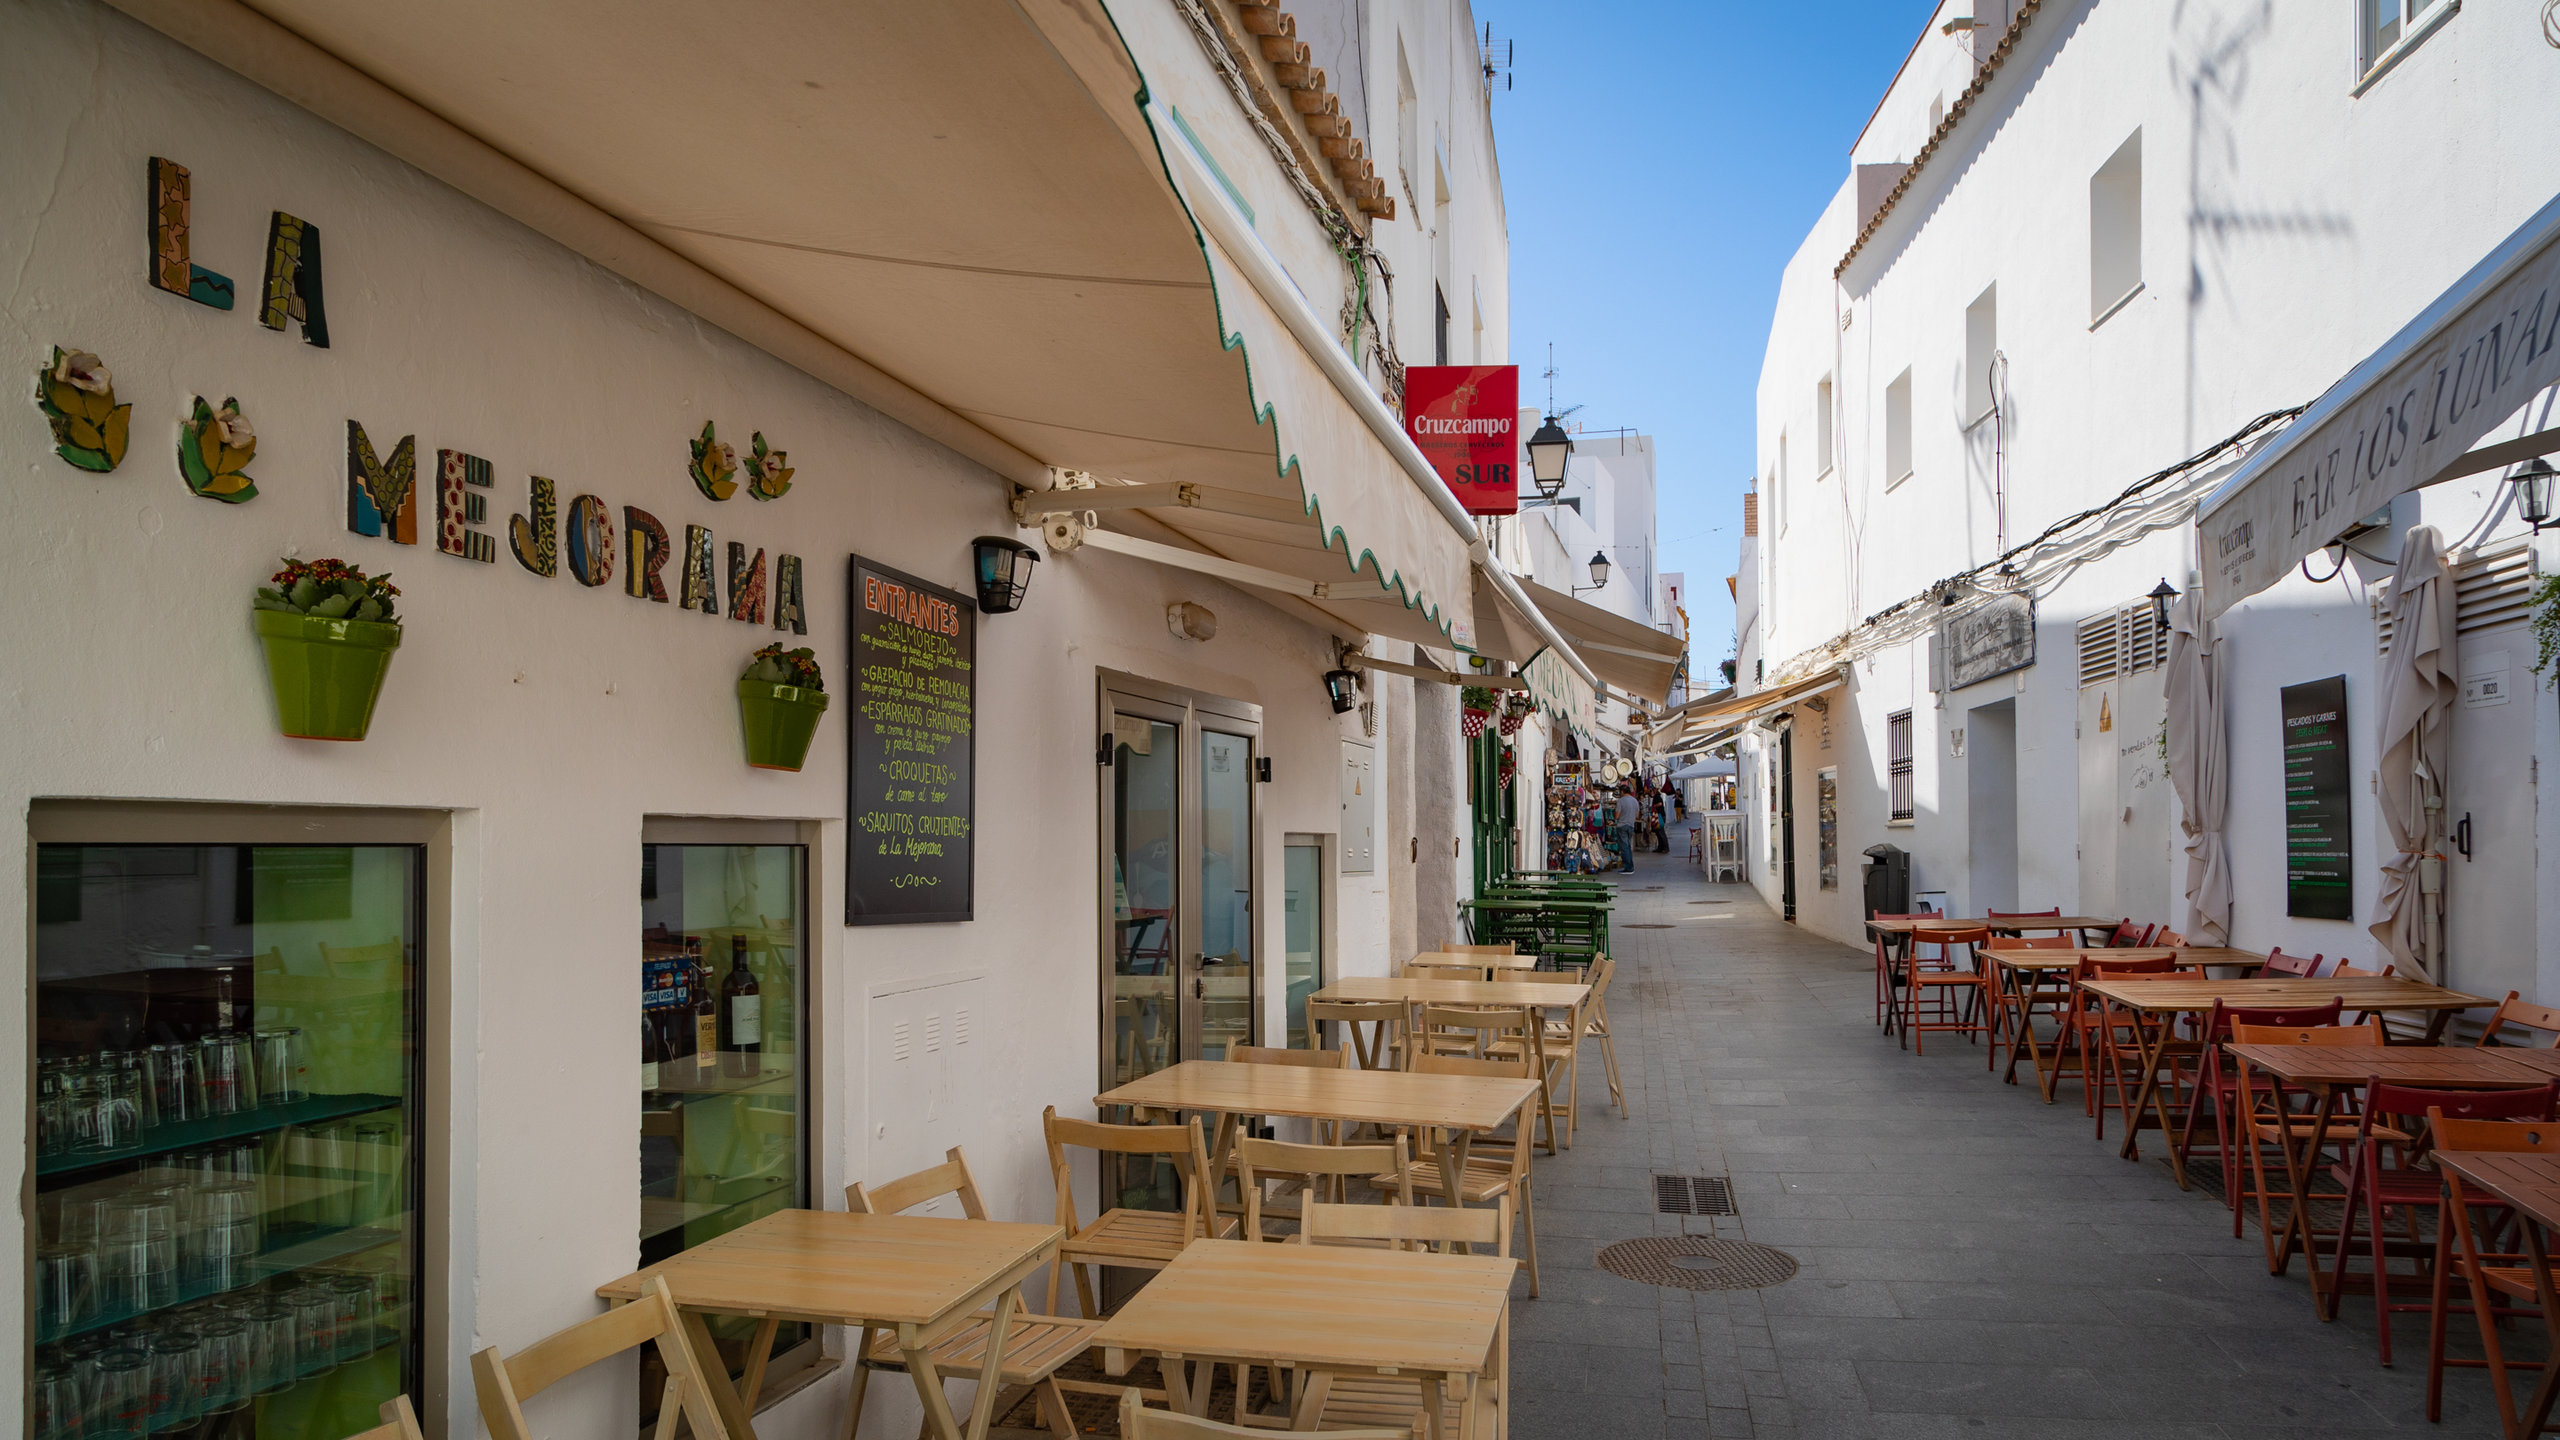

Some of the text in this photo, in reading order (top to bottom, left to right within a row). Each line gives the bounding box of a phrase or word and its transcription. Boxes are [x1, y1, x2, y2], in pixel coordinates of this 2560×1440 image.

[147, 155, 330, 349] LA
[1414, 415, 1510, 438] Cruzcampo
[1455, 463, 1510, 484] SUR
[347, 419, 807, 636] MEJORANA
[865, 575, 960, 637] ENTRANTES
[887, 622, 949, 656] SALMOREJO
[869, 665, 970, 701] GAZPACHO DE REMOLACHA
[868, 700, 970, 737] ESPÁRRAGOS GRATINADOS
[884, 738, 891, 756] y
[889, 759, 948, 786] CROQUETAS
[885, 785, 894, 802] de
[897, 789, 915, 802] carne
[930, 786, 949, 803] toro
[866, 811, 967, 839] SAQUITOS CRUJIENTES
[878, 835, 944, 863] de La Mejorana
[660, 990, 673, 1000] VISA
